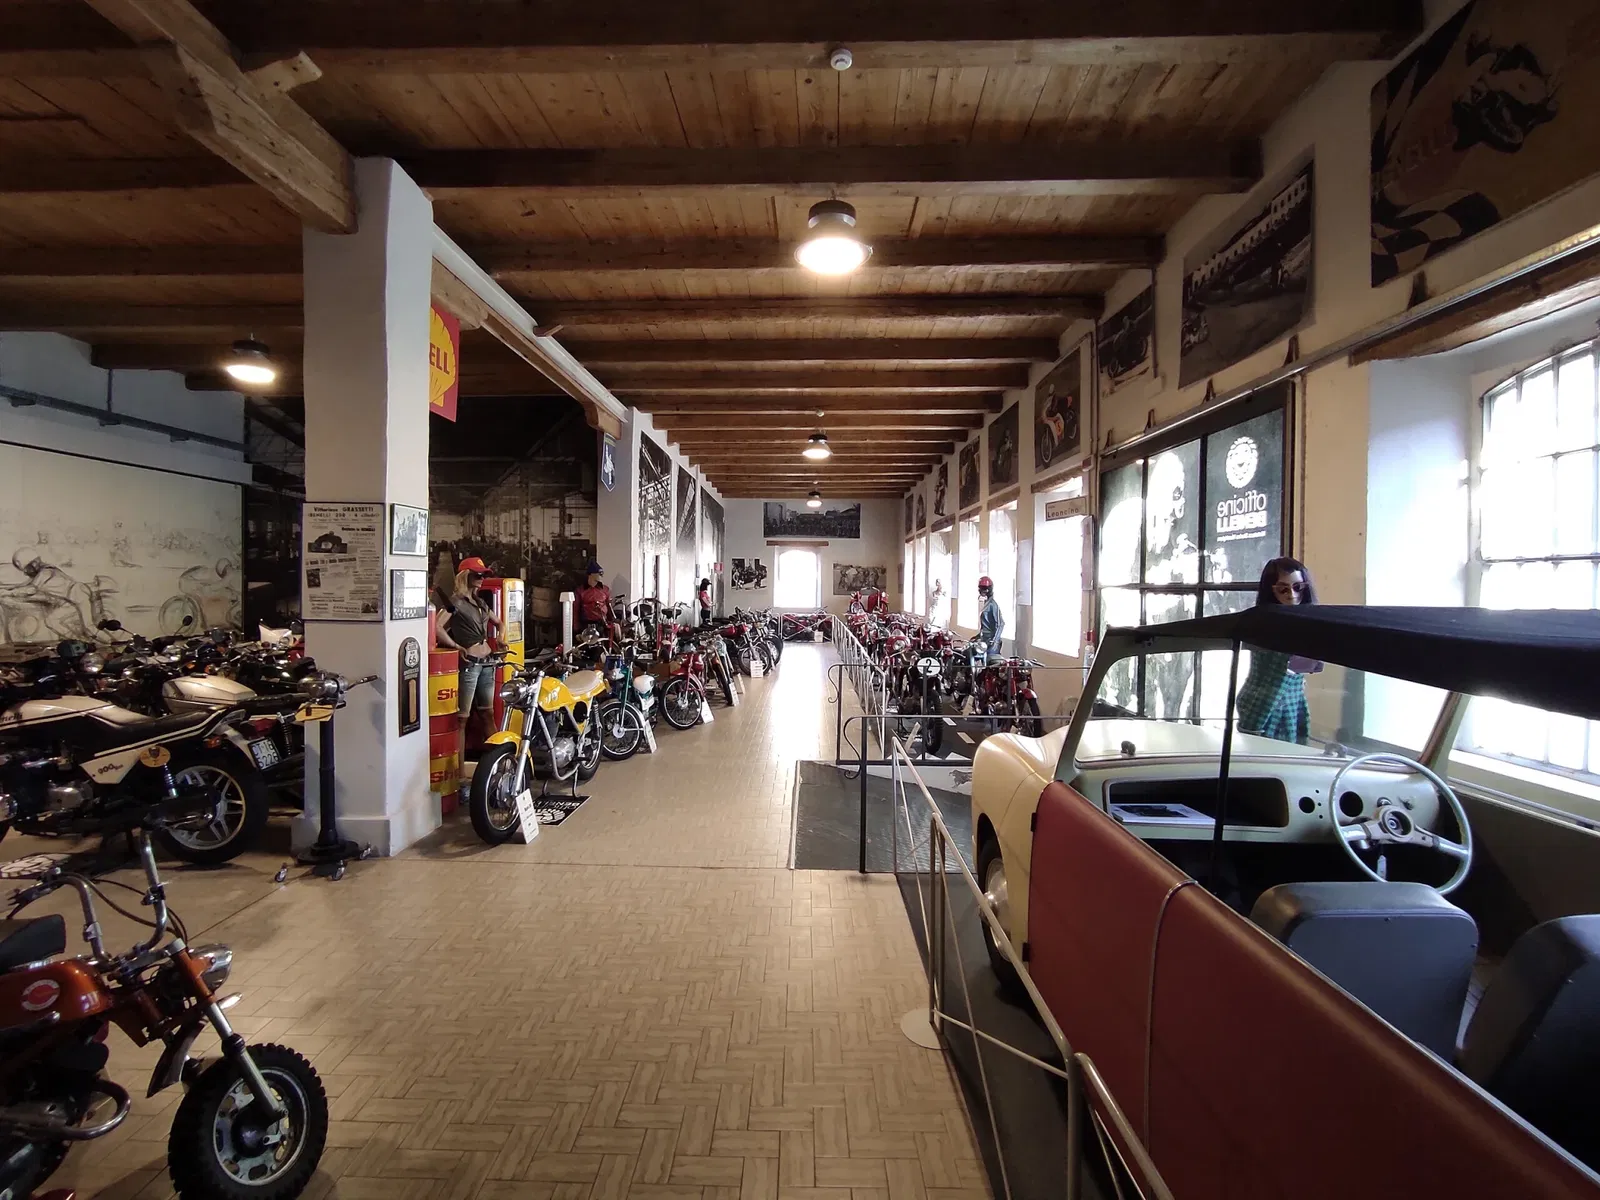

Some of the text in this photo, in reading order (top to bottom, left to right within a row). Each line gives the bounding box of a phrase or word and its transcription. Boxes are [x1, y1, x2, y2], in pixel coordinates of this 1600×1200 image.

[1048, 508, 1079, 518] Leoncino
[409, 655, 416, 665] 66
[925, 658, 933, 674] 2
